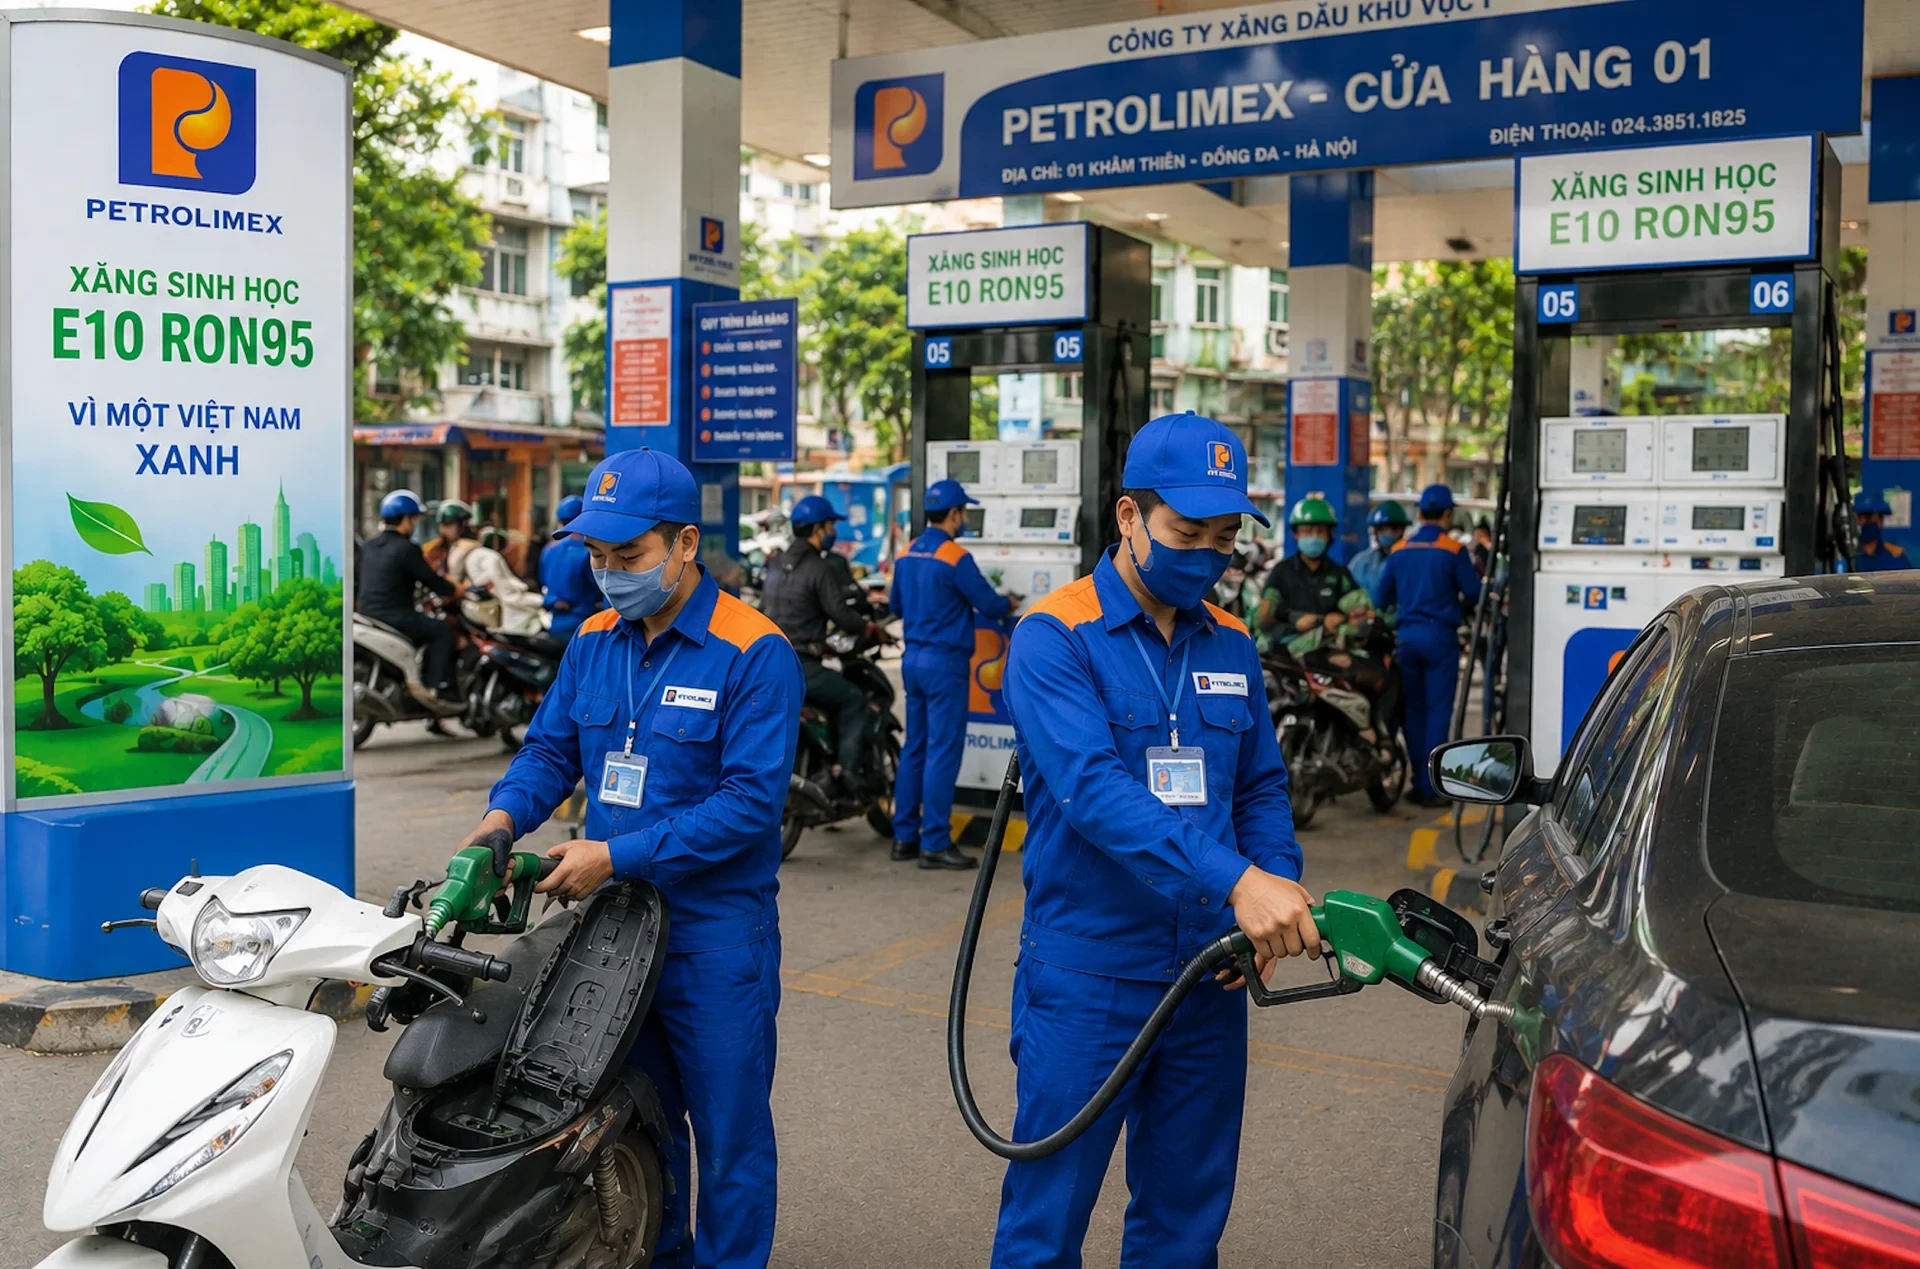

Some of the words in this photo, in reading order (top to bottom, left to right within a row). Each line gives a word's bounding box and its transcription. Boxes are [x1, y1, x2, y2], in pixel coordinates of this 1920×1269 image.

[1182, 24, 1212, 44] TY
[1221, 13, 1288, 41] XĂNG
[1002, 80, 1295, 146] PETROLIMEX
[1345, 53, 1451, 113] CỬA
[1479, 44, 1632, 101] HÀNG
[1654, 38, 1712, 84] 01
[1490, 123, 1534, 147] ĐIỆN
[1541, 120, 1606, 141] THOẠI:
[1611, 109, 1746, 135] 024.3851.1825
[1067, 163, 1084, 178] 01
[1325, 135, 1358, 159] NỘI
[1551, 170, 1628, 201] XĂNG
[1637, 167, 1704, 195] SINH
[1714, 162, 1777, 194] HỌC
[87, 198, 283, 235] PETROLIMEX
[1550, 208, 1619, 245] E10
[1634, 198, 1775, 240] RON95
[928, 250, 975, 272] XĂNG
[981, 249, 1021, 269] SINH
[1027, 246, 1064, 270] HỌC
[70, 262, 158, 296] XĂNG
[168, 271, 235, 301] SINH
[245, 277, 300, 309] HỌC
[928, 280, 971, 305] E10
[980, 273, 1064, 302] RON95
[1542, 290, 1576, 318] 05
[1753, 280, 1790, 309] 06
[53, 308, 144, 361] E10
[162, 312, 314, 368] RON95
[927, 342, 949, 363] 05
[1056, 337, 1080, 358] 05
[68, 396, 96, 426] VÌ
[107, 398, 170, 432] MỘT
[178, 400, 236, 434] VIỆT
[244, 406, 301, 430] NAM
[135, 444, 239, 475] XANH
